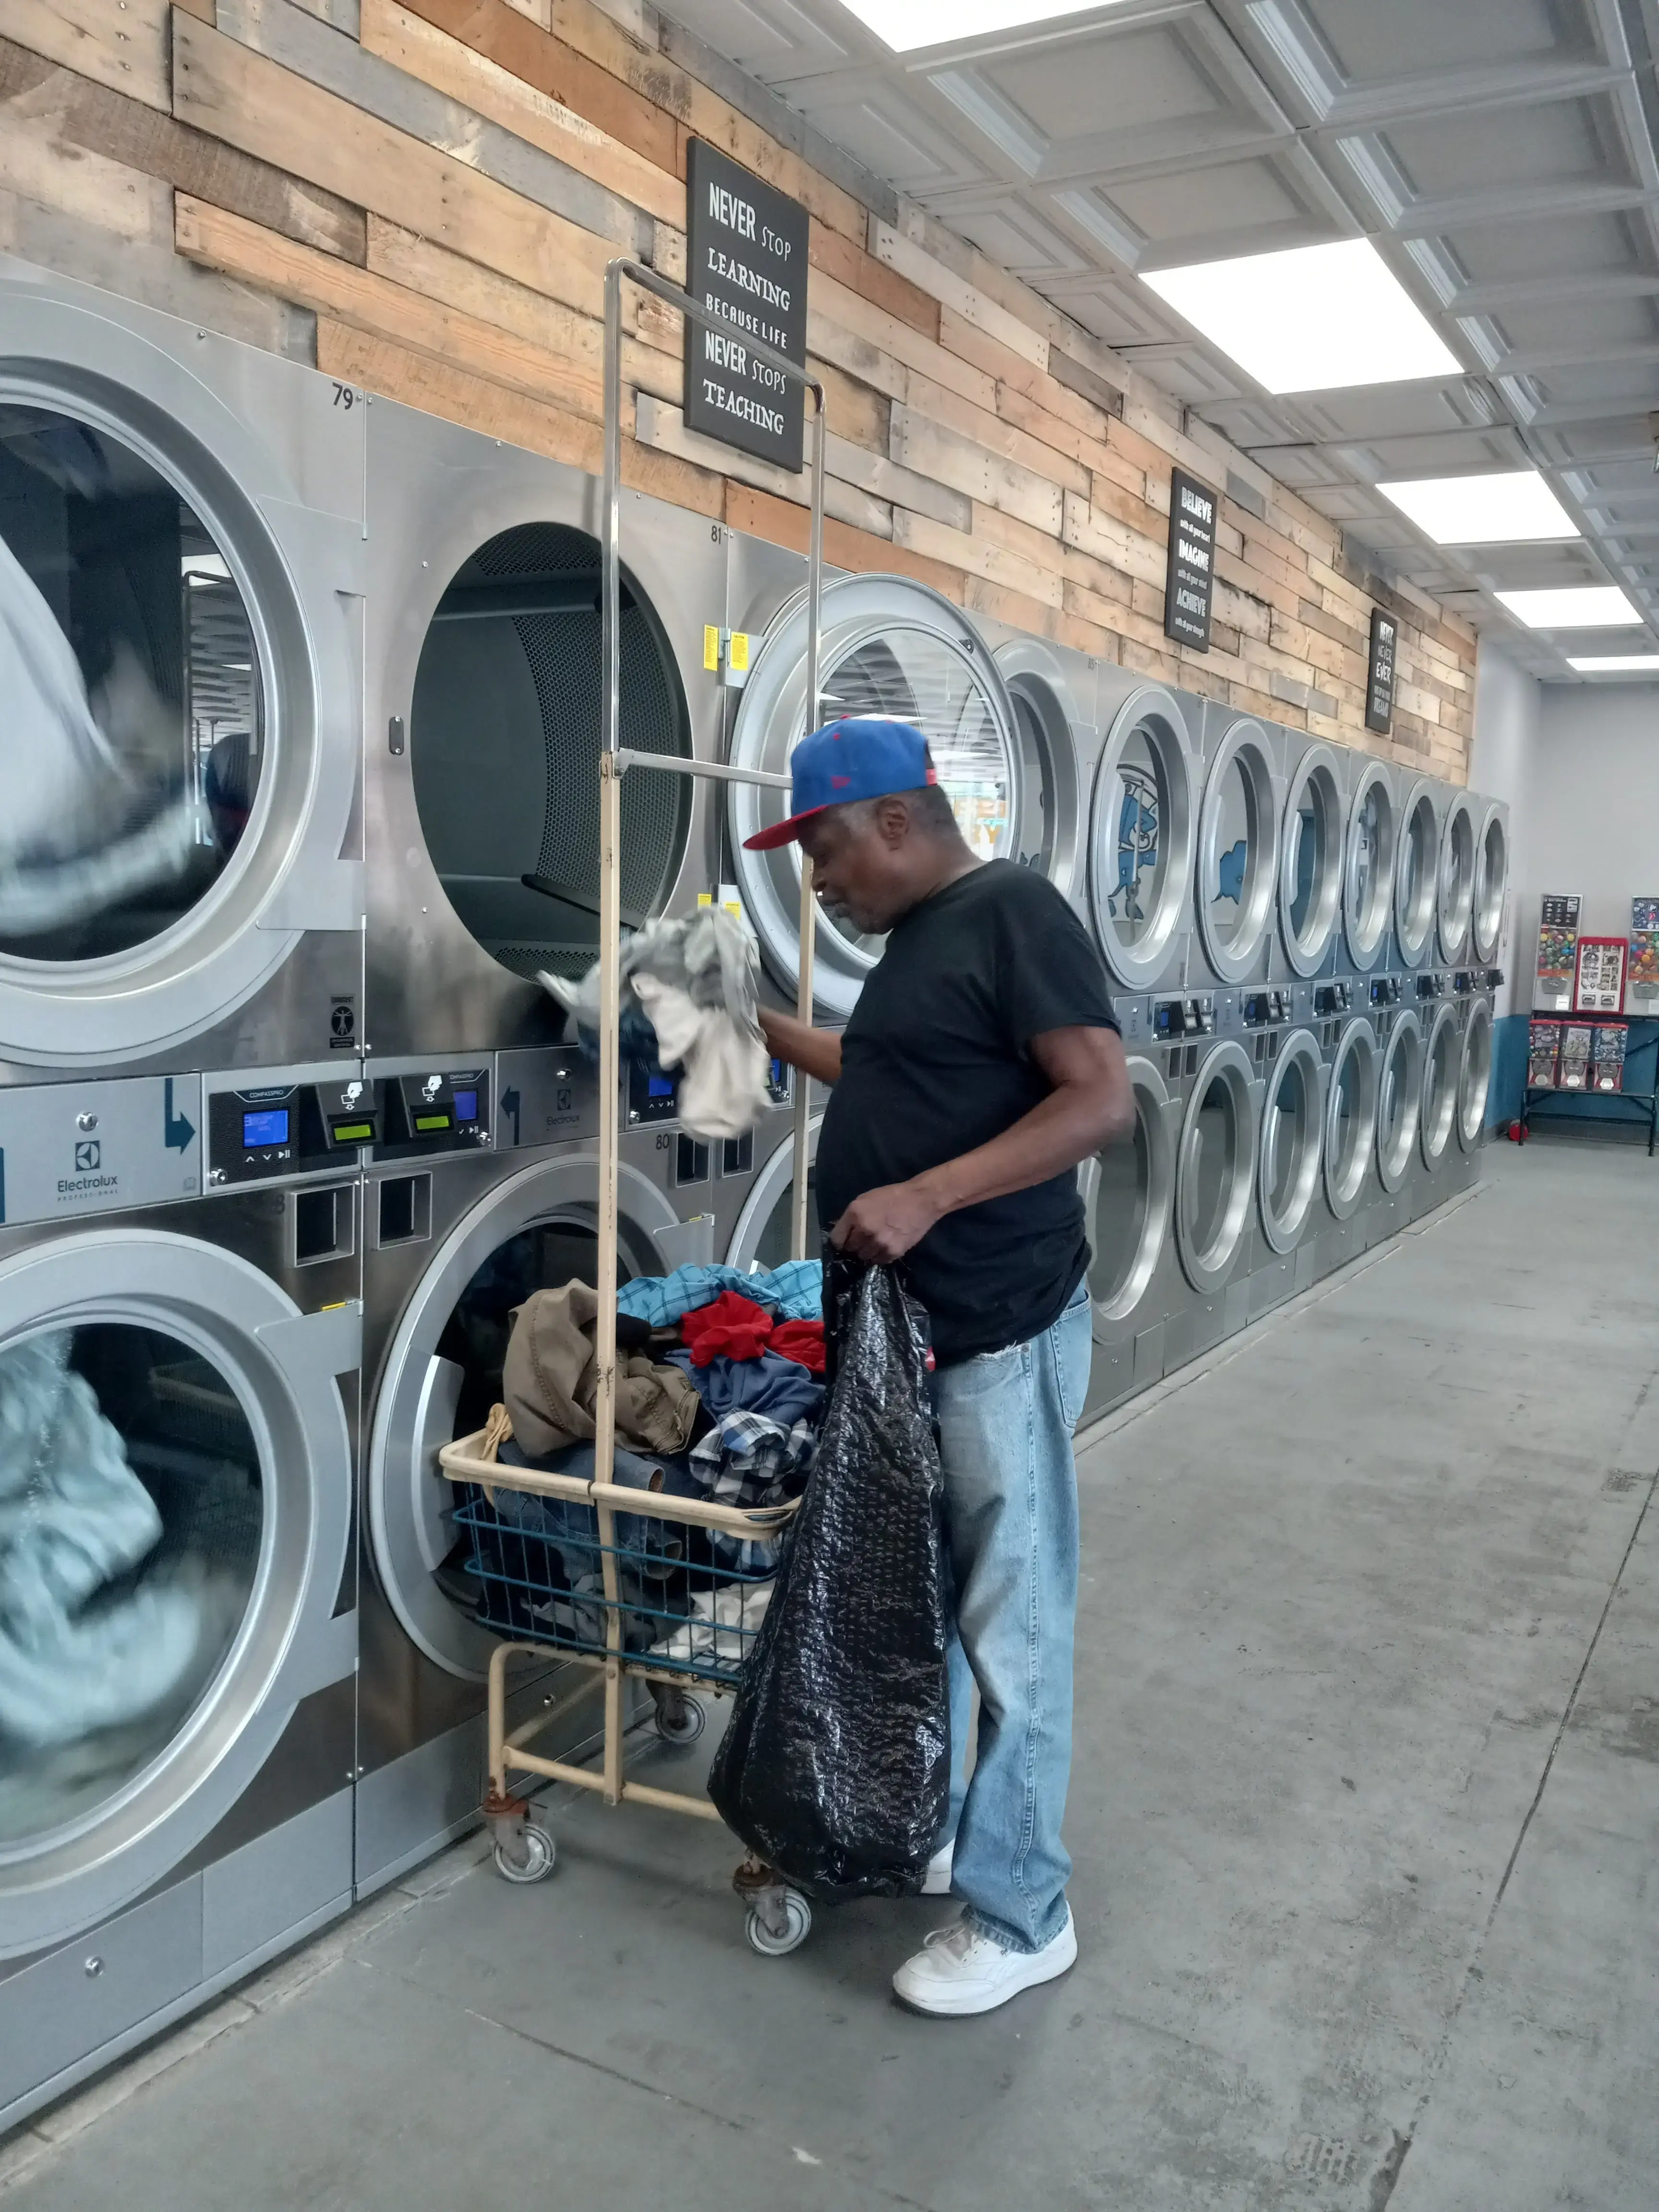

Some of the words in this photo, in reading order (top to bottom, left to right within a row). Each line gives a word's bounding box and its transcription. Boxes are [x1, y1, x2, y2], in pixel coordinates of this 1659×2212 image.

[709, 181, 756, 241] NEVER
[761, 226, 792, 262] STOP
[708, 247, 791, 311] LEARNING
[706, 292, 759, 335] BECAUSE
[762, 322, 787, 349] LIFE
[705, 330, 746, 376] NEVER
[752, 359, 787, 395] STOPS
[332, 382, 353, 410] 79
[703, 378, 784, 435] TEACHING
[1181, 486, 1212, 524] BELIEVE
[711, 525, 721, 545] 81
[1179, 538, 1209, 572] IMAGINE
[1176, 587, 1206, 617] ACHIEVE
[656, 1133, 669, 1150] 80
[57, 1175, 119, 1192] Electrolux
